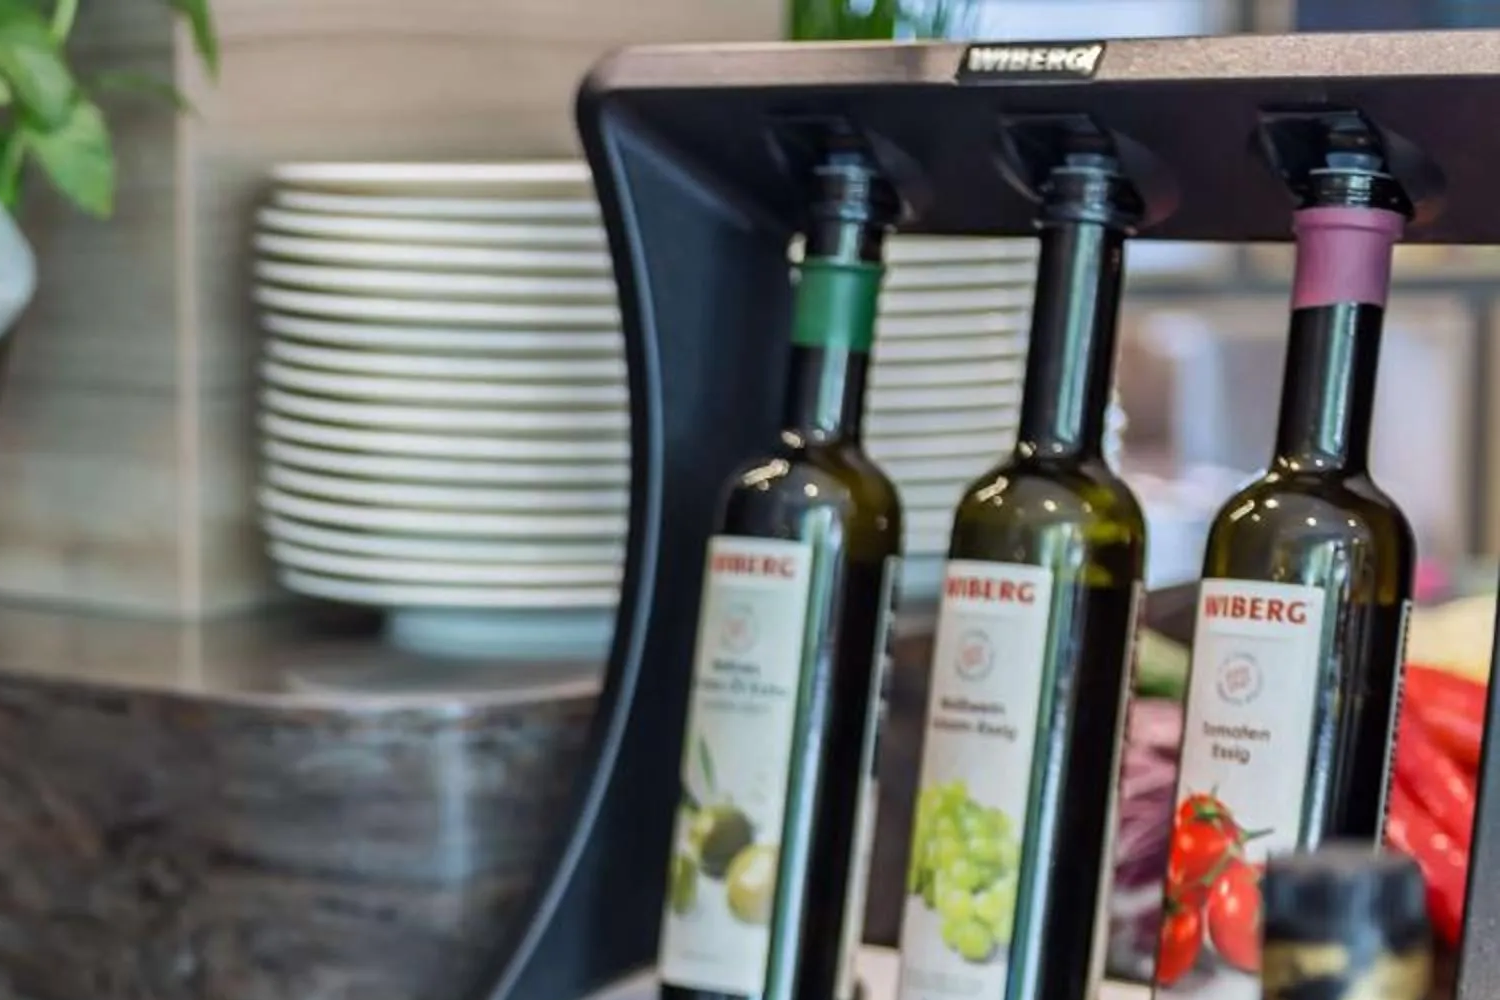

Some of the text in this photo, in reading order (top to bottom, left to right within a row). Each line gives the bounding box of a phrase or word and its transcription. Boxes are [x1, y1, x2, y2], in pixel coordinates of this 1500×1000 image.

[969, 46, 1102, 76] WIBERG
[711, 554, 796, 579] WIBERG
[945, 576, 1036, 605] WIBERG
[1204, 595, 1308, 625] WIBERG
